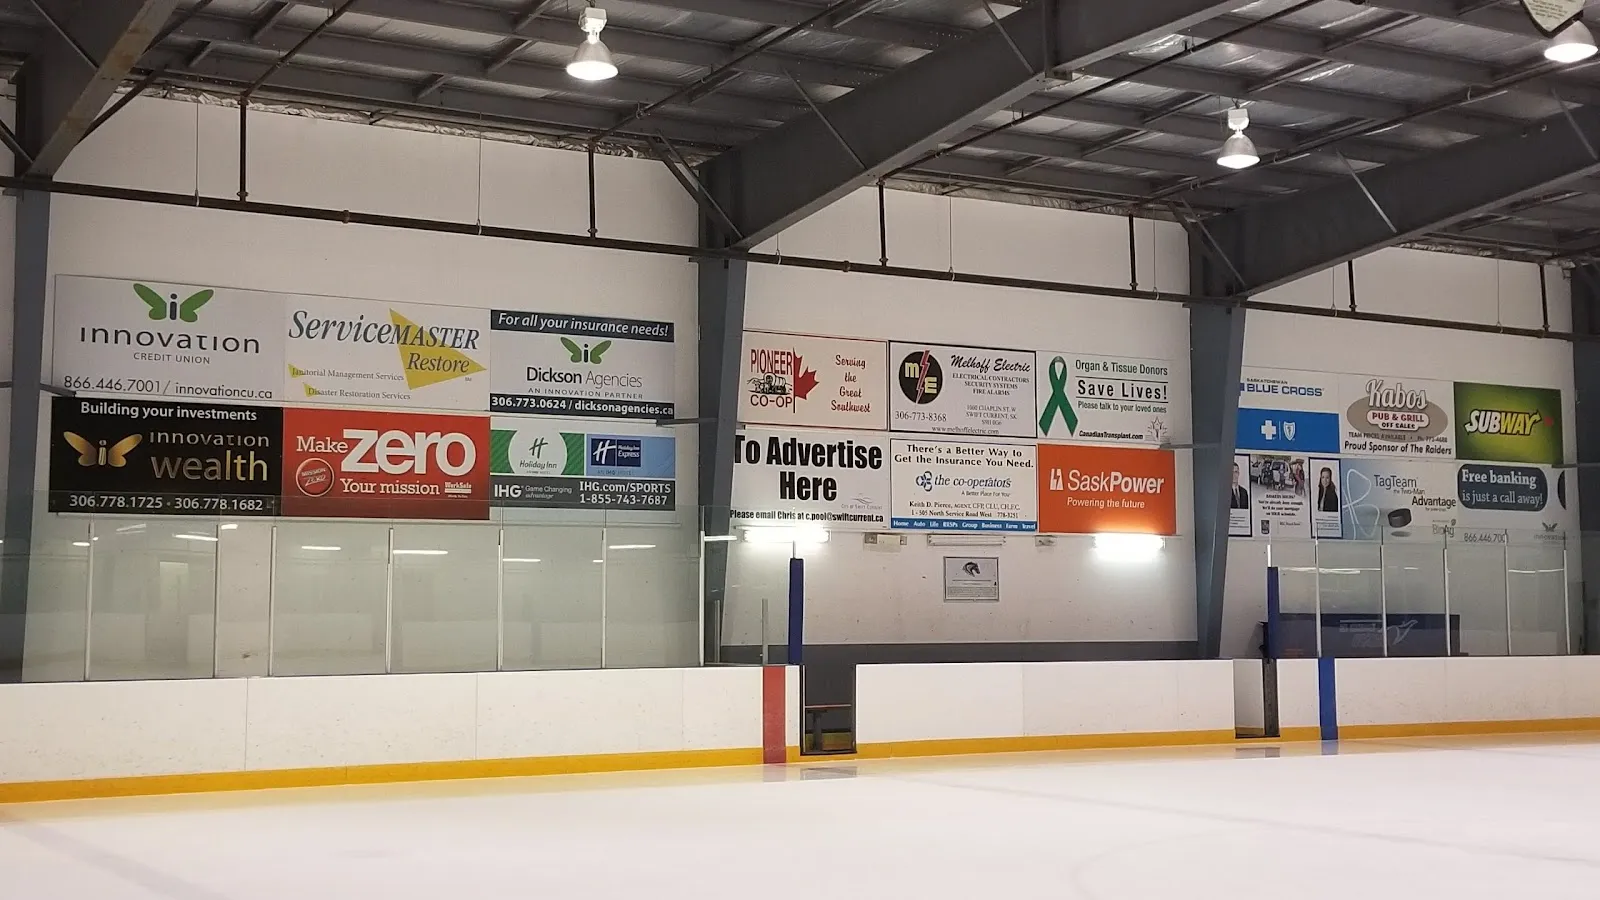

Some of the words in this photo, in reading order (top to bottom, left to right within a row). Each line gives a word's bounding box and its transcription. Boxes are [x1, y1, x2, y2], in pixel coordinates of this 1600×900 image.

[288, 310, 480, 350] ServiceMASTER
[498, 313, 520, 326] For
[522, 315, 538, 326] all
[539, 318, 568, 330] your
[570, 318, 628, 334] insurance
[631, 324, 668, 336] needs!
[80, 327, 260, 354] innovation
[133, 352, 171, 362] CREDIT
[176, 354, 210, 364] UNION
[406, 352, 470, 373] Restore
[750, 348, 792, 375] PIONEER
[835, 354, 866, 370] Serving
[950, 355, 990, 373] Melhoff
[994, 358, 1030, 372] Electric
[1076, 360, 1100, 373] Organ
[1102, 362, 1108, 372] &
[1111, 362, 1137, 374] Tissue
[1140, 364, 1168, 375] Donors
[328, 370, 374, 380] Management
[376, 372, 404, 381] Services
[526, 366, 582, 384] Dickson
[586, 370, 642, 390] Agencies
[844, 372, 857, 383] the
[64, 376, 160, 393] 866.446.7001
[176, 382, 272, 399] innovationcu.ca
[308, 387, 338, 397] Disaster
[340, 389, 380, 399] Restoration
[382, 391, 410, 400] Services
[544, 388, 600, 397] INNOVATION
[840, 386, 862, 398] Great
[1078, 380, 1114, 396] Save
[1122, 382, 1167, 400] Lives!
[1247, 384, 1279, 393] BLUE
[1282, 386, 1322, 396] CROSS
[1366, 379, 1428, 409] Kabos
[492, 396, 566, 410] 306.773.0624
[574, 400, 673, 415] dicksonagencies.ca
[750, 394, 792, 408] CO-OP
[831, 400, 871, 412] Southwest
[1078, 401, 1098, 410] Please
[1100, 402, 1111, 410] talk
[1113, 403, 1118, 411] to
[1120, 404, 1133, 413] your
[1135, 404, 1151, 412] loved
[80, 402, 138, 418] Building
[142, 406, 174, 419] your
[176, 406, 257, 421] investments
[894, 411, 947, 422] 306-773-8368
[1372, 412, 1389, 420] PUB
[1401, 414, 1424, 422] GRILL
[1464, 409, 1542, 436] SUBWAY
[150, 432, 270, 447] innovation
[1079, 430, 1143, 440] CanadianTransplant.com
[296, 436, 348, 453] Make
[341, 428, 476, 476] zero
[907, 444, 942, 454] There's
[956, 446, 984, 456] Better
[988, 448, 1008, 458] Way
[1013, 449, 1022, 457] to
[1344, 441, 1366, 450] Proud
[1369, 442, 1398, 452] Sponsor
[1401, 444, 1408, 452] of
[1410, 444, 1423, 453] The
[1426, 445, 1452, 454] Raiders
[618, 450, 640, 458] Express
[766, 436, 882, 469] Advertise
[151, 450, 268, 481] wealth
[520, 460, 546, 470] Holiday
[894, 454, 911, 463] Get
[916, 455, 932, 463] the
[936, 456, 982, 466] Insurance
[986, 458, 1003, 466] You
[1006, 459, 1034, 468] Need.
[340, 478, 376, 494] Your
[380, 480, 440, 495] mission
[579, 480, 671, 493] IHG.com/SPORTS
[780, 471, 837, 501] Here
[935, 475, 950, 486] the
[953, 477, 1012, 488] co-operators
[1068, 469, 1164, 494] SaskPower
[1374, 475, 1417, 490] TagTeam
[1462, 469, 1487, 483] Free
[1489, 469, 1536, 489] banking
[494, 484, 522, 498] IHG
[544, 486, 572, 494] Changing
[69, 495, 163, 509] 306.778.1725
[174, 498, 263, 511] 306.778.1682
[580, 494, 668, 505] 1-855-743-7687
[1067, 497, 1104, 509] Powering
[1106, 498, 1120, 508] the
[1121, 499, 1145, 508] future
[1412, 495, 1456, 509] Advantage
[1462, 490, 1470, 501] is
[1472, 490, 1490, 505] just
[1492, 494, 1498, 502] a
[1500, 491, 1515, 503] call
[1518, 493, 1543, 507] away!
[730, 510, 754, 519] Please
[756, 510, 775, 520] email
[777, 511, 796, 520] Chris
[797, 512, 805, 520] at
[806, 511, 883, 522] c.pool@swiftcurrent.ca
